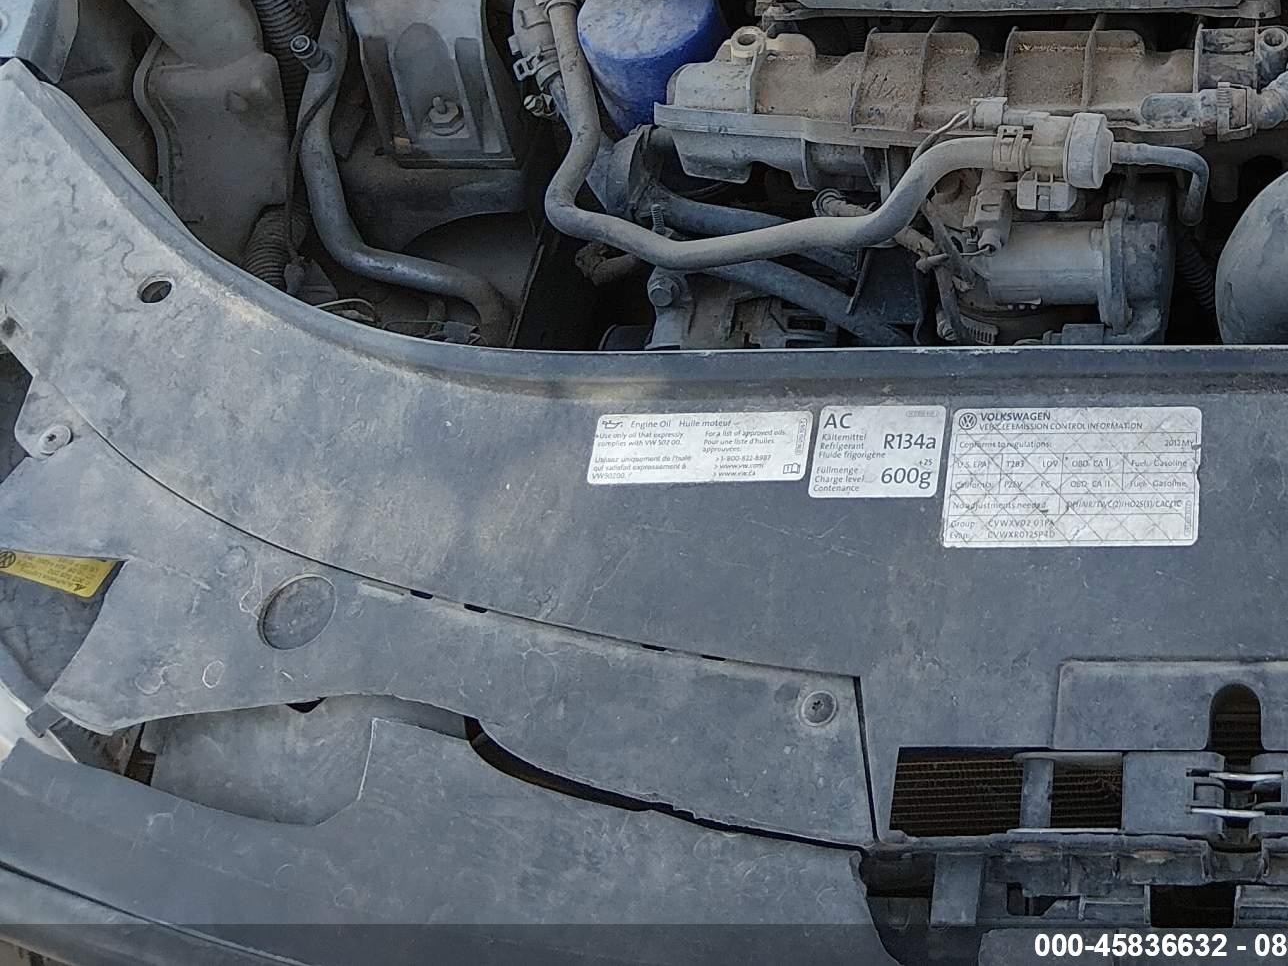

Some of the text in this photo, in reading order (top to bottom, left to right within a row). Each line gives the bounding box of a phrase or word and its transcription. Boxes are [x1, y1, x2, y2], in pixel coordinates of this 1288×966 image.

[823, 413, 852, 429] AC
[980, 412, 1051, 422] VOLKSWAGEN
[630, 420, 671, 430] Engine Oil
[679, 420, 700, 428] Huile
[980, 421, 1143, 431] VEHICLE EMISSION CONTROL INFORMATION
[821, 433, 867, 442] Kältemittel
[883, 433, 937, 450] R134a
[820, 442, 864, 451] Refrigerant
[959, 441, 996, 449] Conforms
[1164, 439, 1180, 447] 2012
[818, 451, 843, 459] Fluide
[973, 460, 987, 468] EPA
[1042, 460, 1058, 468] LDV
[1153, 459, 1187, 467] Gasoline
[816, 466, 859, 476] Füllmenge
[814, 475, 865, 485] Charge level
[881, 467, 933, 490] 600g
[813, 484, 860, 493] Contenance
